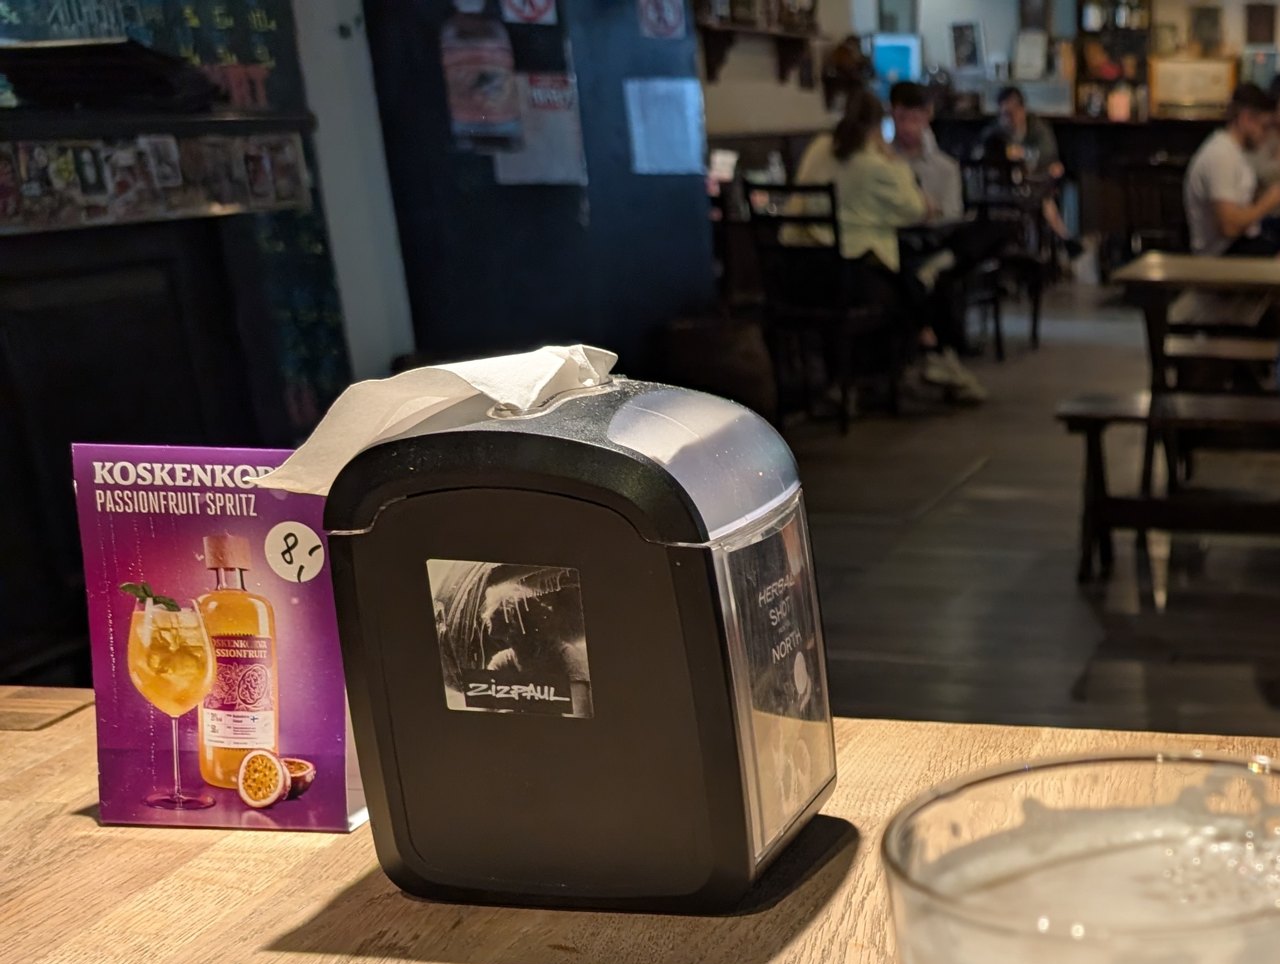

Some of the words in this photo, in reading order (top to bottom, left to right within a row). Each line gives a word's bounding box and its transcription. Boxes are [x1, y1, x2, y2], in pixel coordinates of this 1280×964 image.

[93, 461, 280, 488] KOSKENKO
[96, 490, 201, 514] PASSIONFRUIT
[206, 494, 257, 516] SPRITZ
[758, 574, 795, 607] HERBAL
[769, 597, 790, 626] SHOT
[772, 629, 802, 664] NORTH
